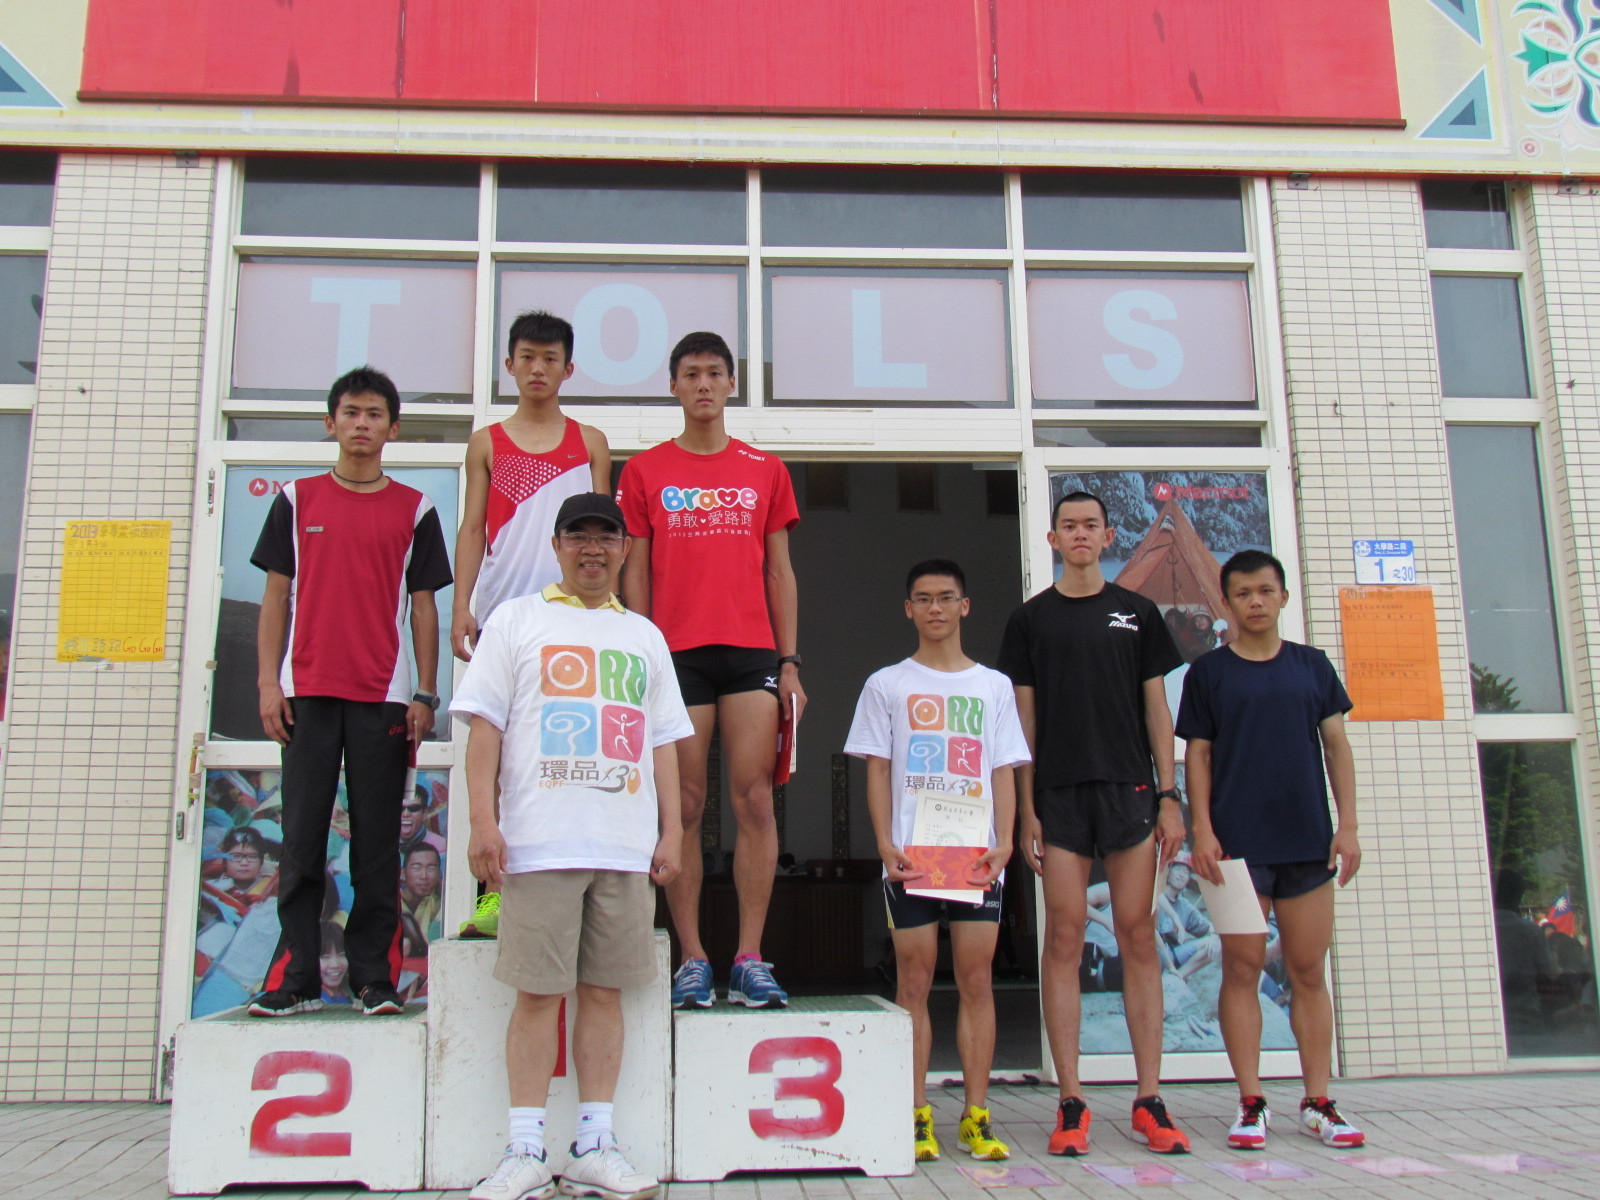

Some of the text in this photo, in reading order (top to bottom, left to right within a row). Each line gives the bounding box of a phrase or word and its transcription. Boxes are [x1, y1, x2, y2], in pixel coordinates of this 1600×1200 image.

[310, 277, 1184, 390] T O L S
[661, 486, 758, 512] Brave
[1174, 485, 1250, 499] Marmot
[668, 510, 753, 529] 勇敢 愛路跑
[70, 524, 98, 539] 2013
[1374, 558, 1385, 582] 1
[539, 760, 600, 781] 環品
[539, 780, 565, 789] EQPF
[904, 775, 945, 791] 環品
[748, 1036, 845, 1141] 3
[249, 1050, 352, 1158] 2
